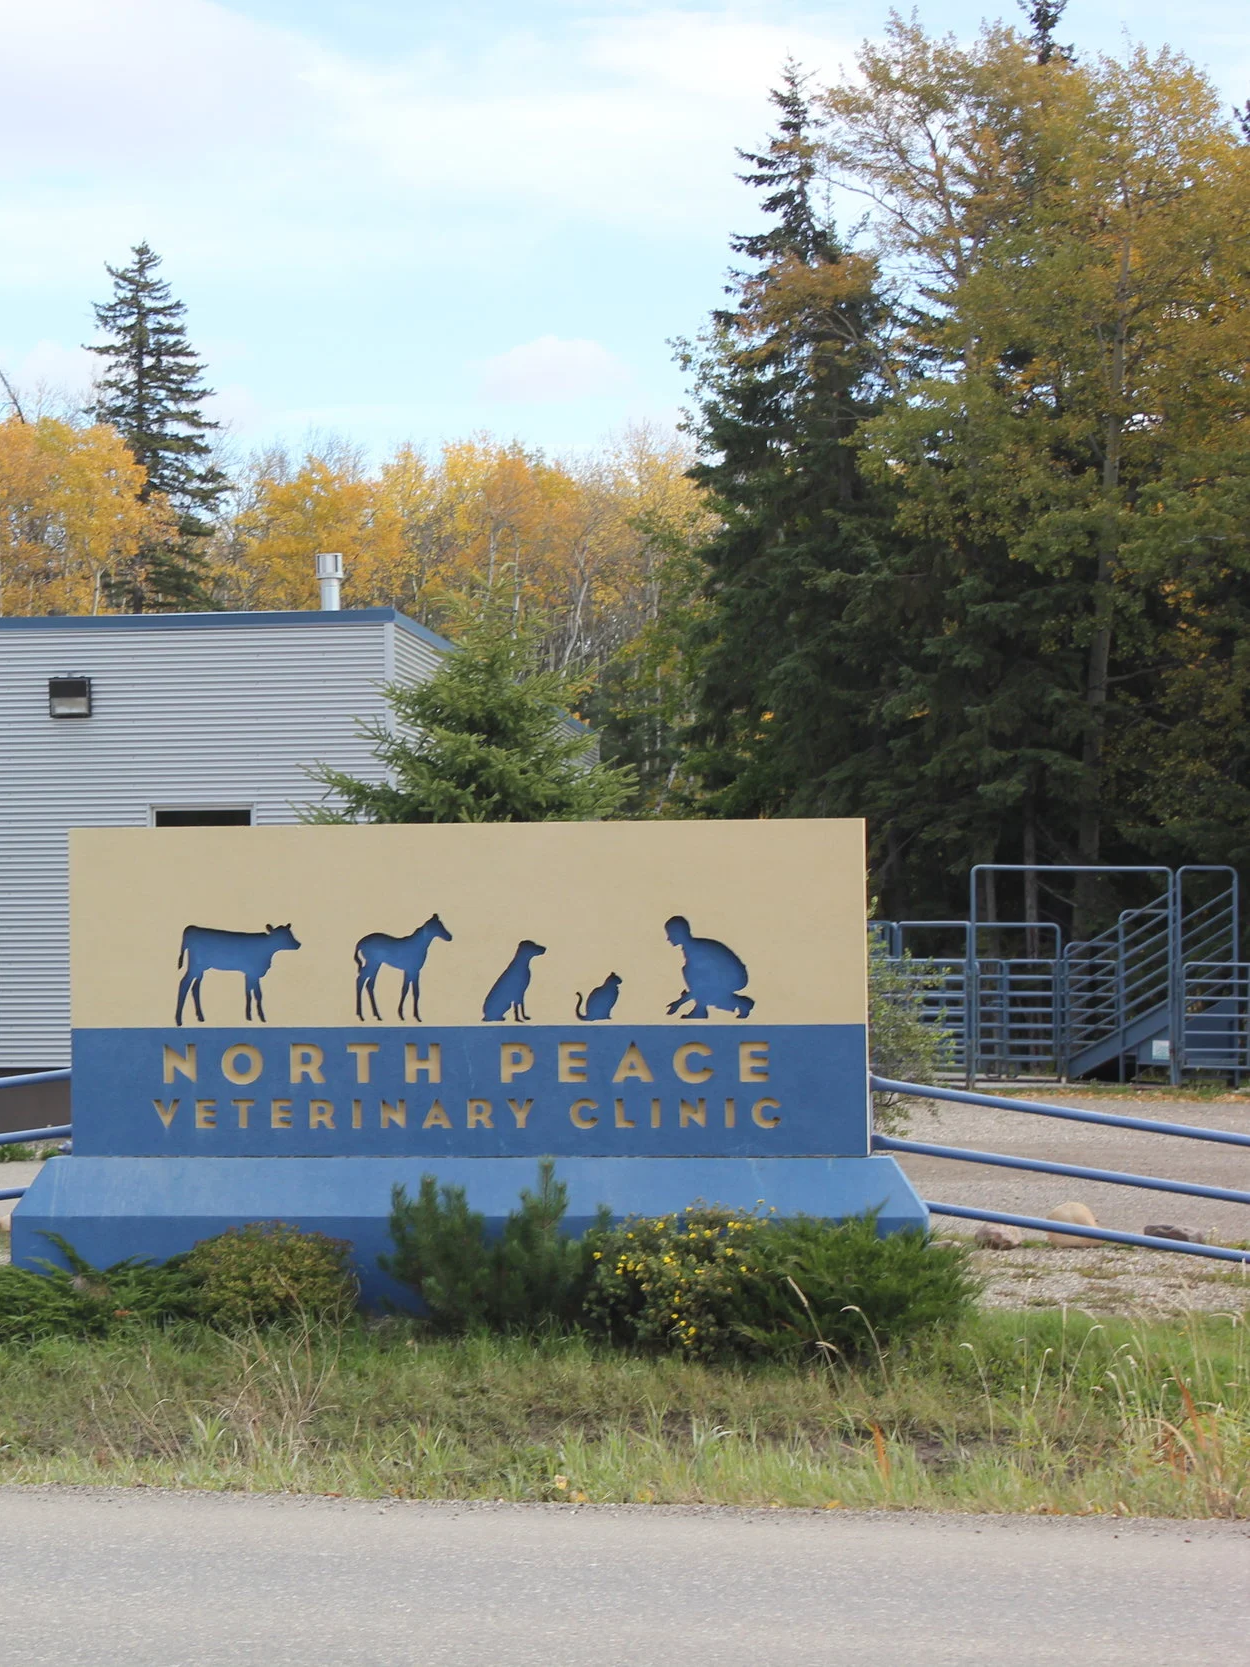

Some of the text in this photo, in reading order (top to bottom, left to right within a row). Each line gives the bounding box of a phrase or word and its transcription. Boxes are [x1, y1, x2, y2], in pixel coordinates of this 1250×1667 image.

[162, 1041, 770, 1085] NORTH PEACE
[153, 1097, 782, 1129] VETERINARY CLINIC
